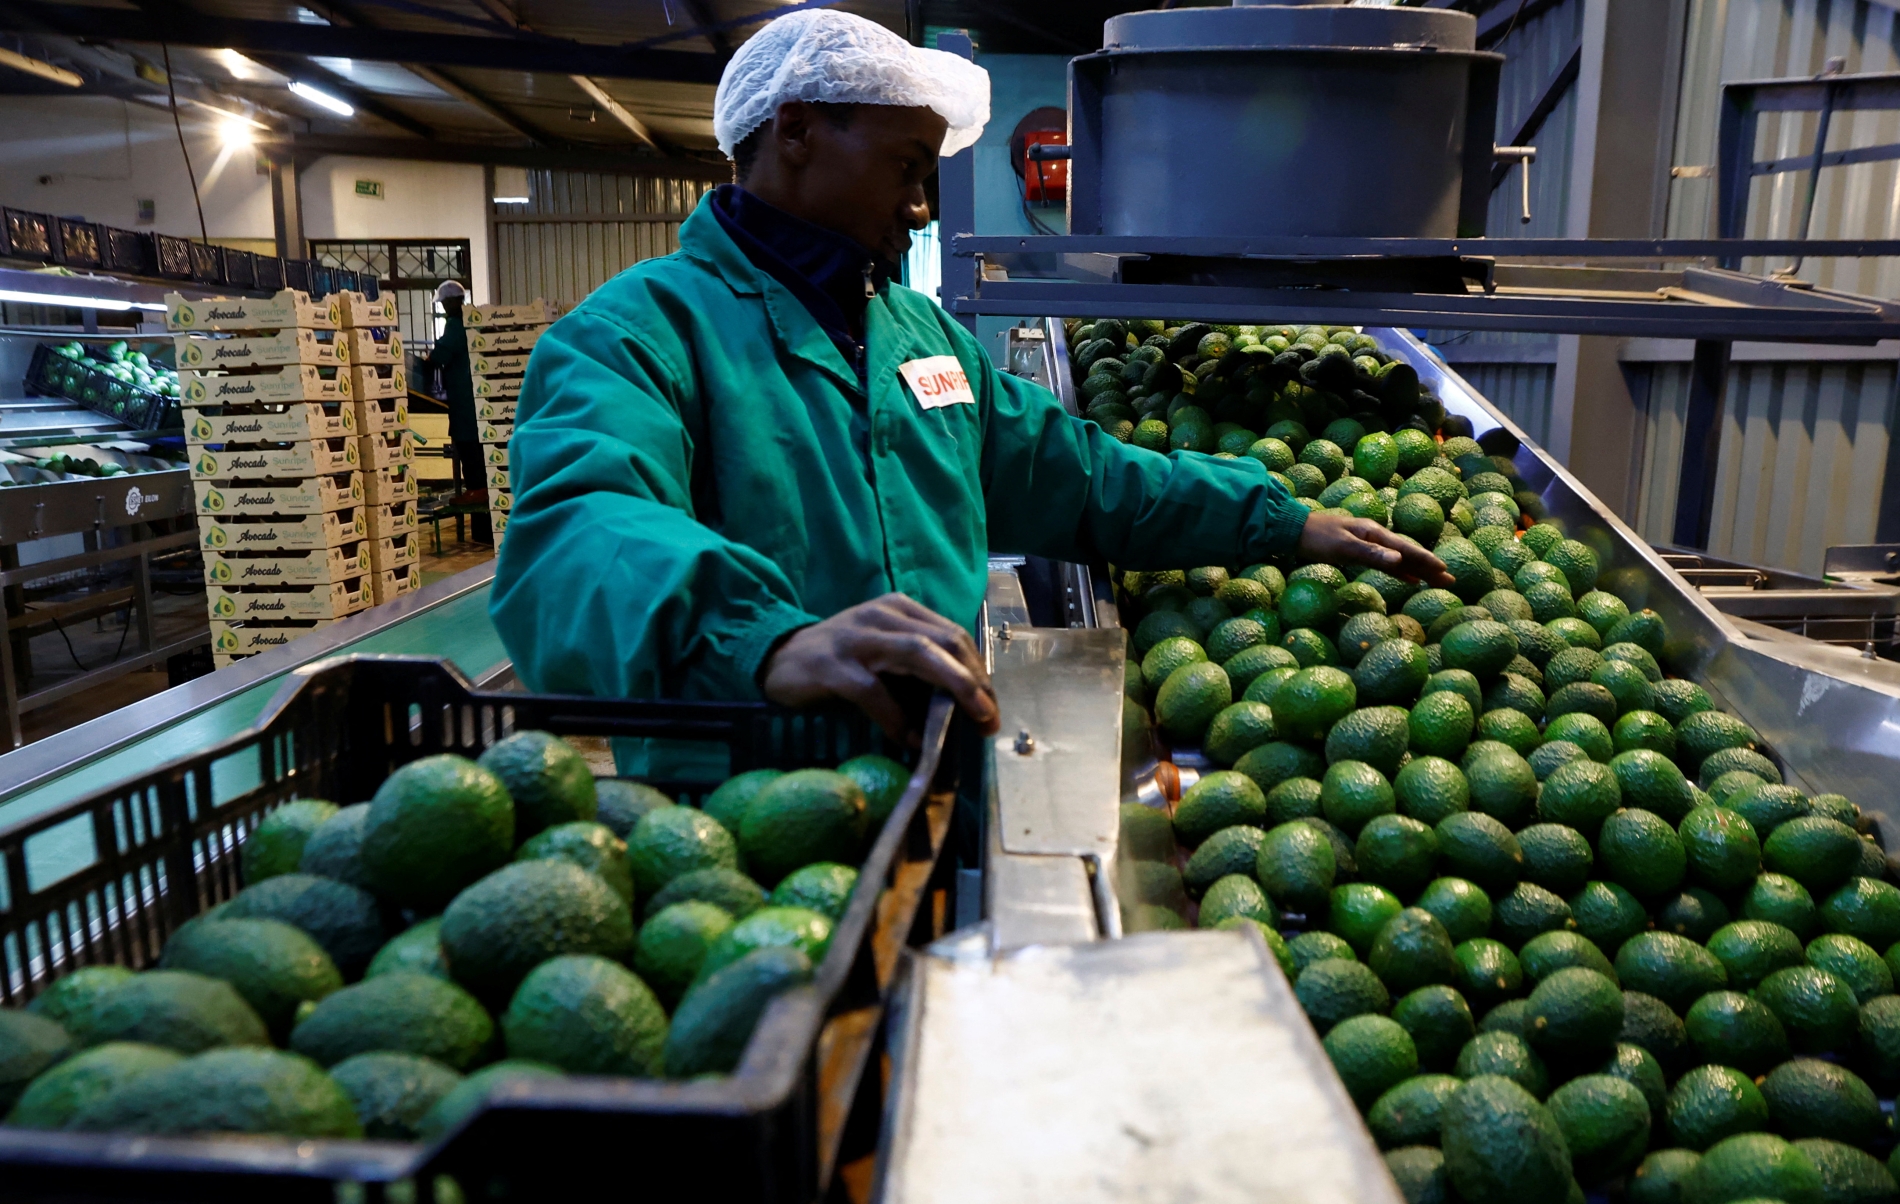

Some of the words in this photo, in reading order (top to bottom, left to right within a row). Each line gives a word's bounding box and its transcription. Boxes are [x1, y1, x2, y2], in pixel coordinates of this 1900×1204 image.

[205, 306, 247, 322] Avocado
[492, 335, 518, 346] Avocado
[212, 344, 252, 360] Avocado
[495, 359, 522, 369] Avocado
[215, 381, 255, 397] Avocado
[497, 382, 522, 392] Avocad
[222, 420, 263, 435] Avocado
[227, 456, 268, 471] Avocado
[234, 492, 275, 507] Avocado
[237, 529, 277, 543] Avocado
[241, 563, 282, 578] Avocado
[245, 599, 285, 613] Avocado
[248, 634, 288, 647] Avocado
